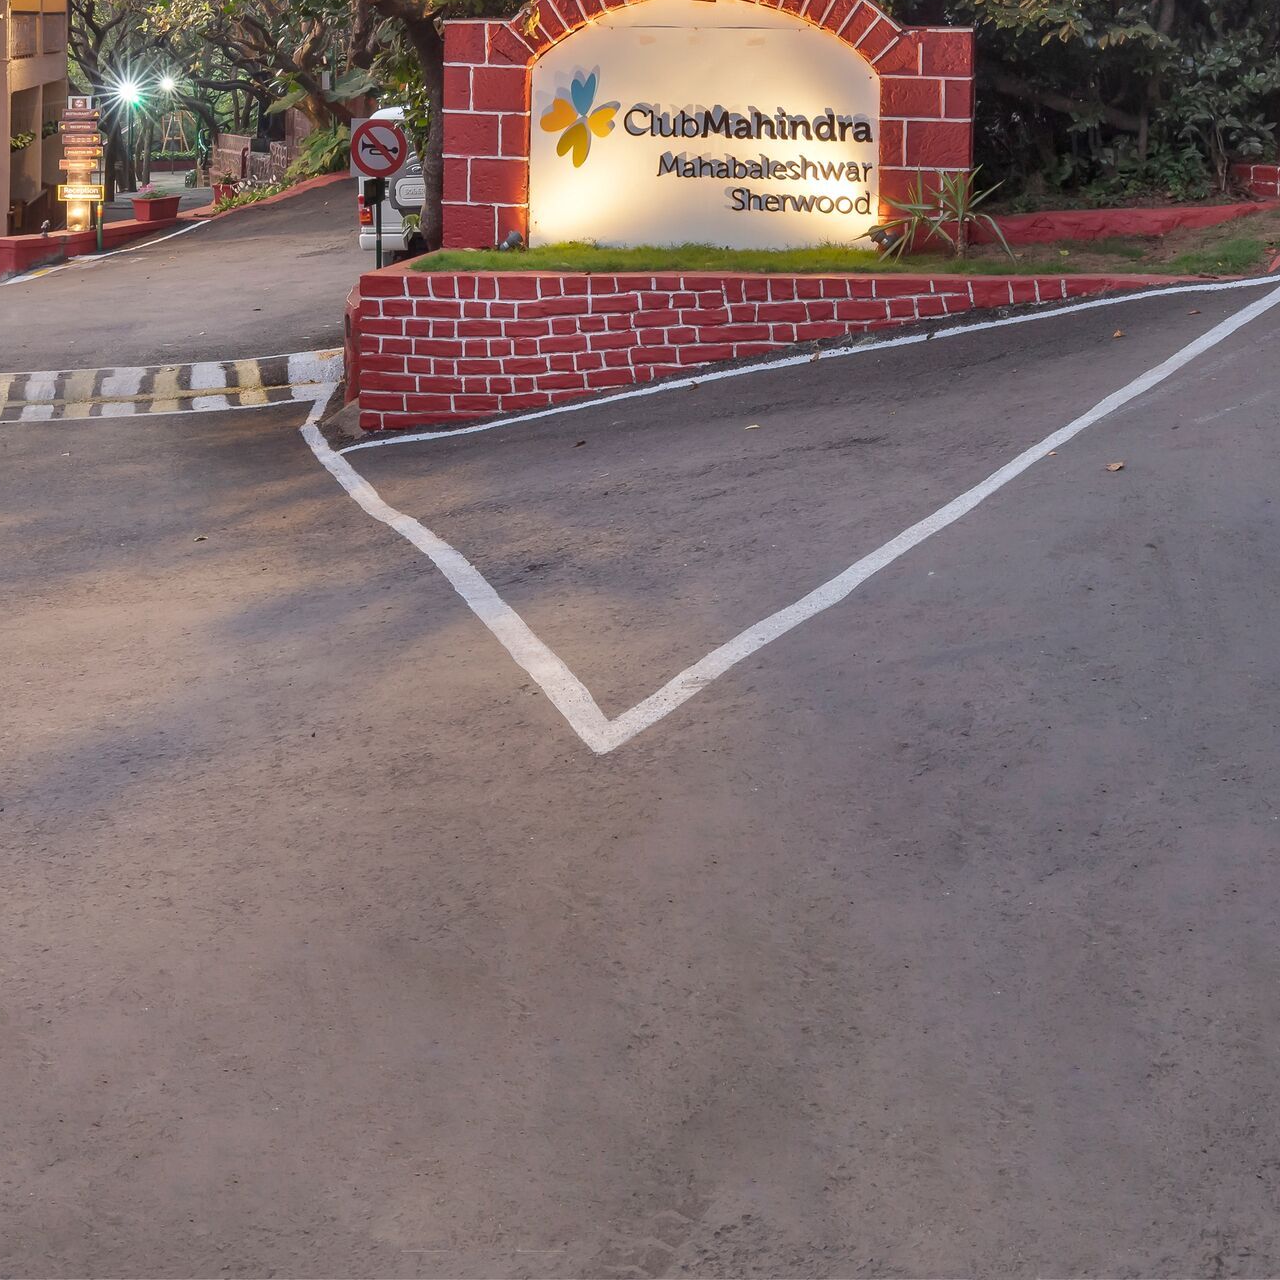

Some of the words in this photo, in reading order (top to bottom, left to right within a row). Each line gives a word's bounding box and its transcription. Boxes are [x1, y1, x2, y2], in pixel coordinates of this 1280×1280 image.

[624, 108, 873, 143] ClubMahindra
[656, 154, 872, 183] Mahabaleshwar
[63, 186, 99, 194] Reception
[731, 187, 872, 215] Sherwood
